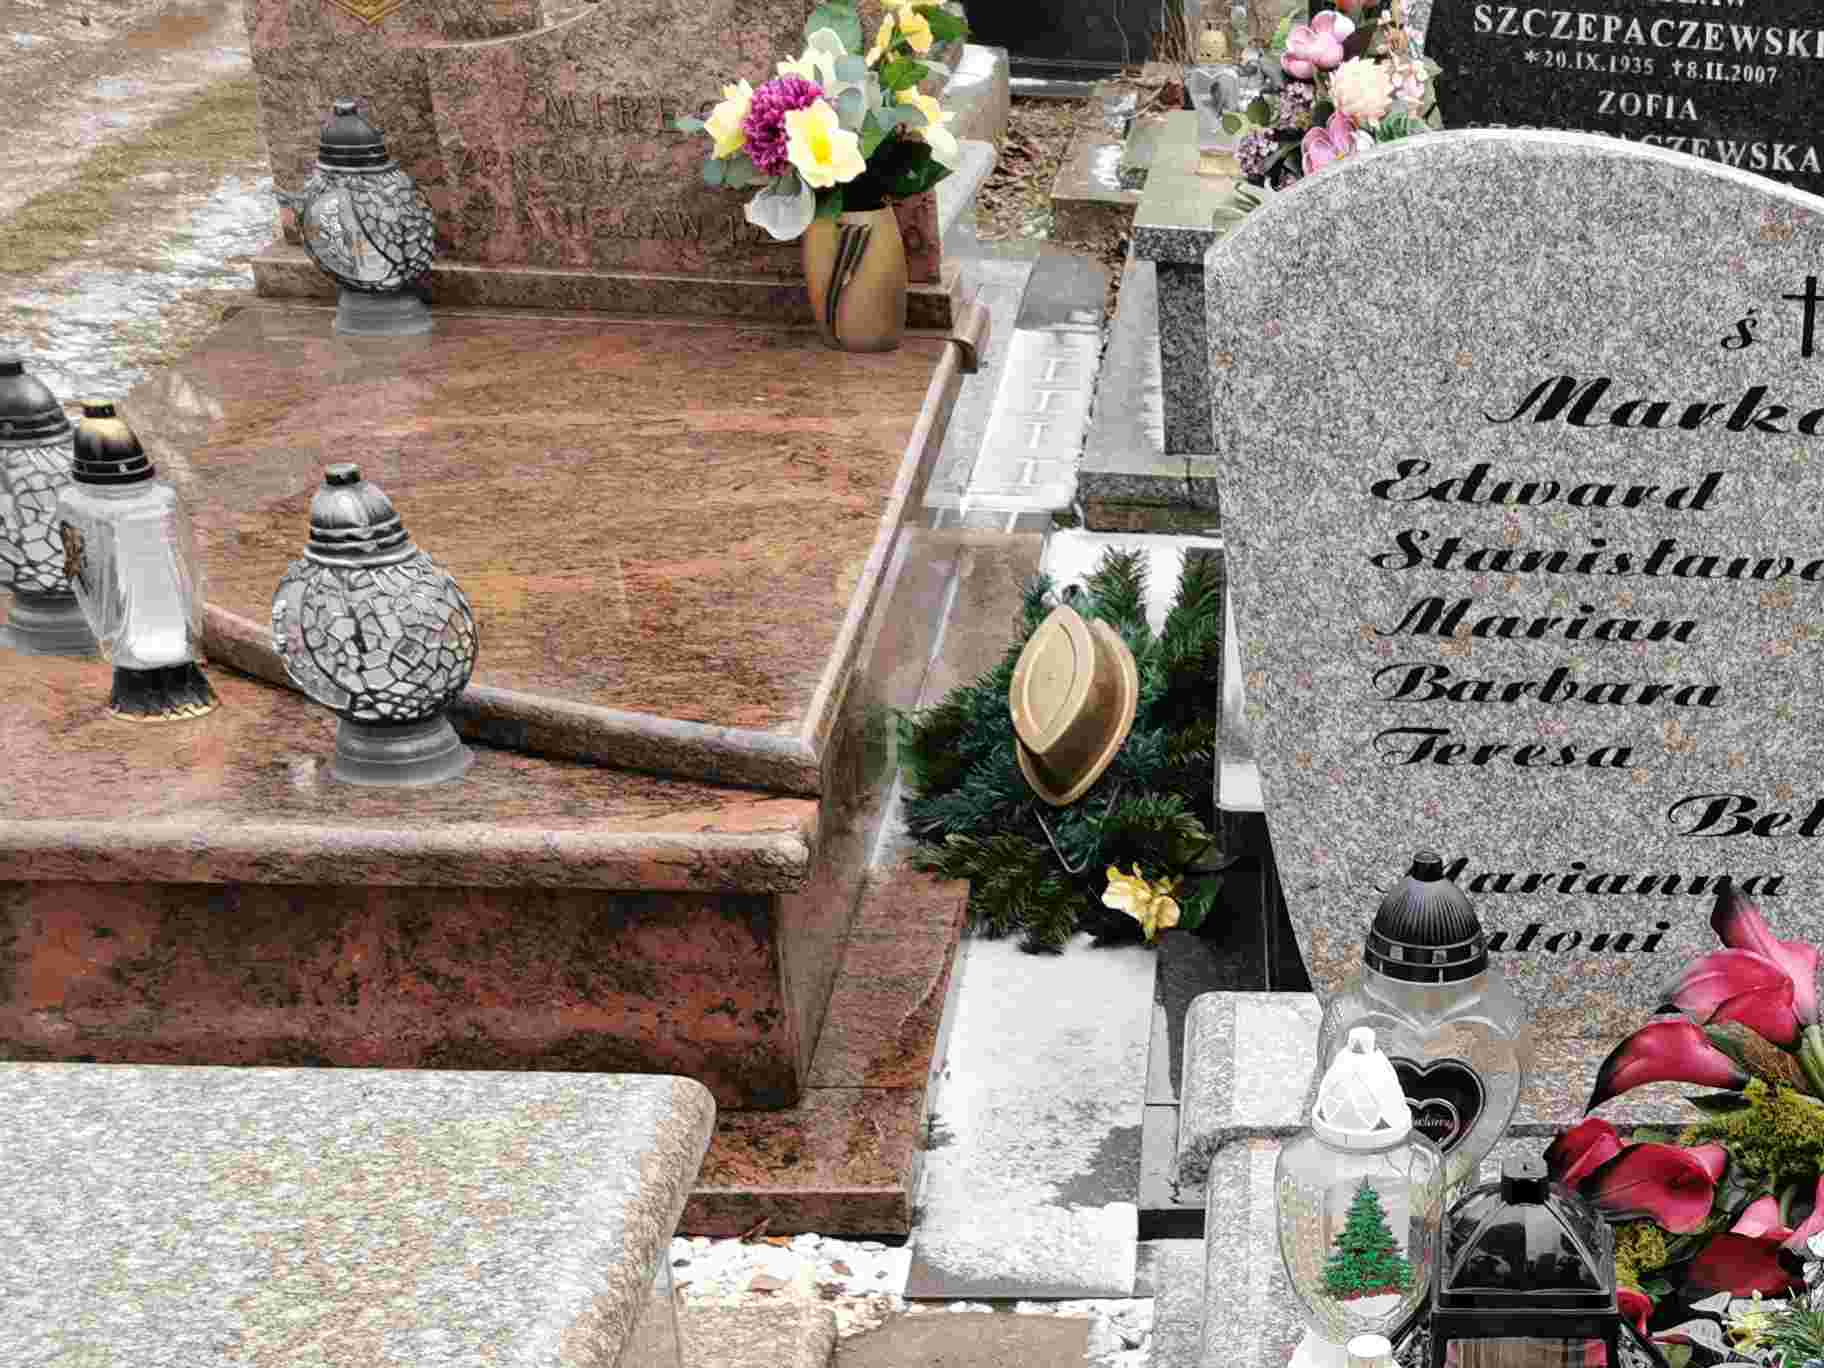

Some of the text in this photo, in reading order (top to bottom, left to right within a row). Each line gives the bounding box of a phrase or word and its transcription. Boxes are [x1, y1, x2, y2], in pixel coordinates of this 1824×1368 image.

[1597, 90, 1700, 121] ZOFIA
[1370, 458, 1724, 511] Edward
[1375, 597, 1702, 643] Marian
[1371, 661, 1724, 708] Barbara
[1372, 727, 1635, 770] Teresa
[1481, 920, 1674, 953] ntoni
